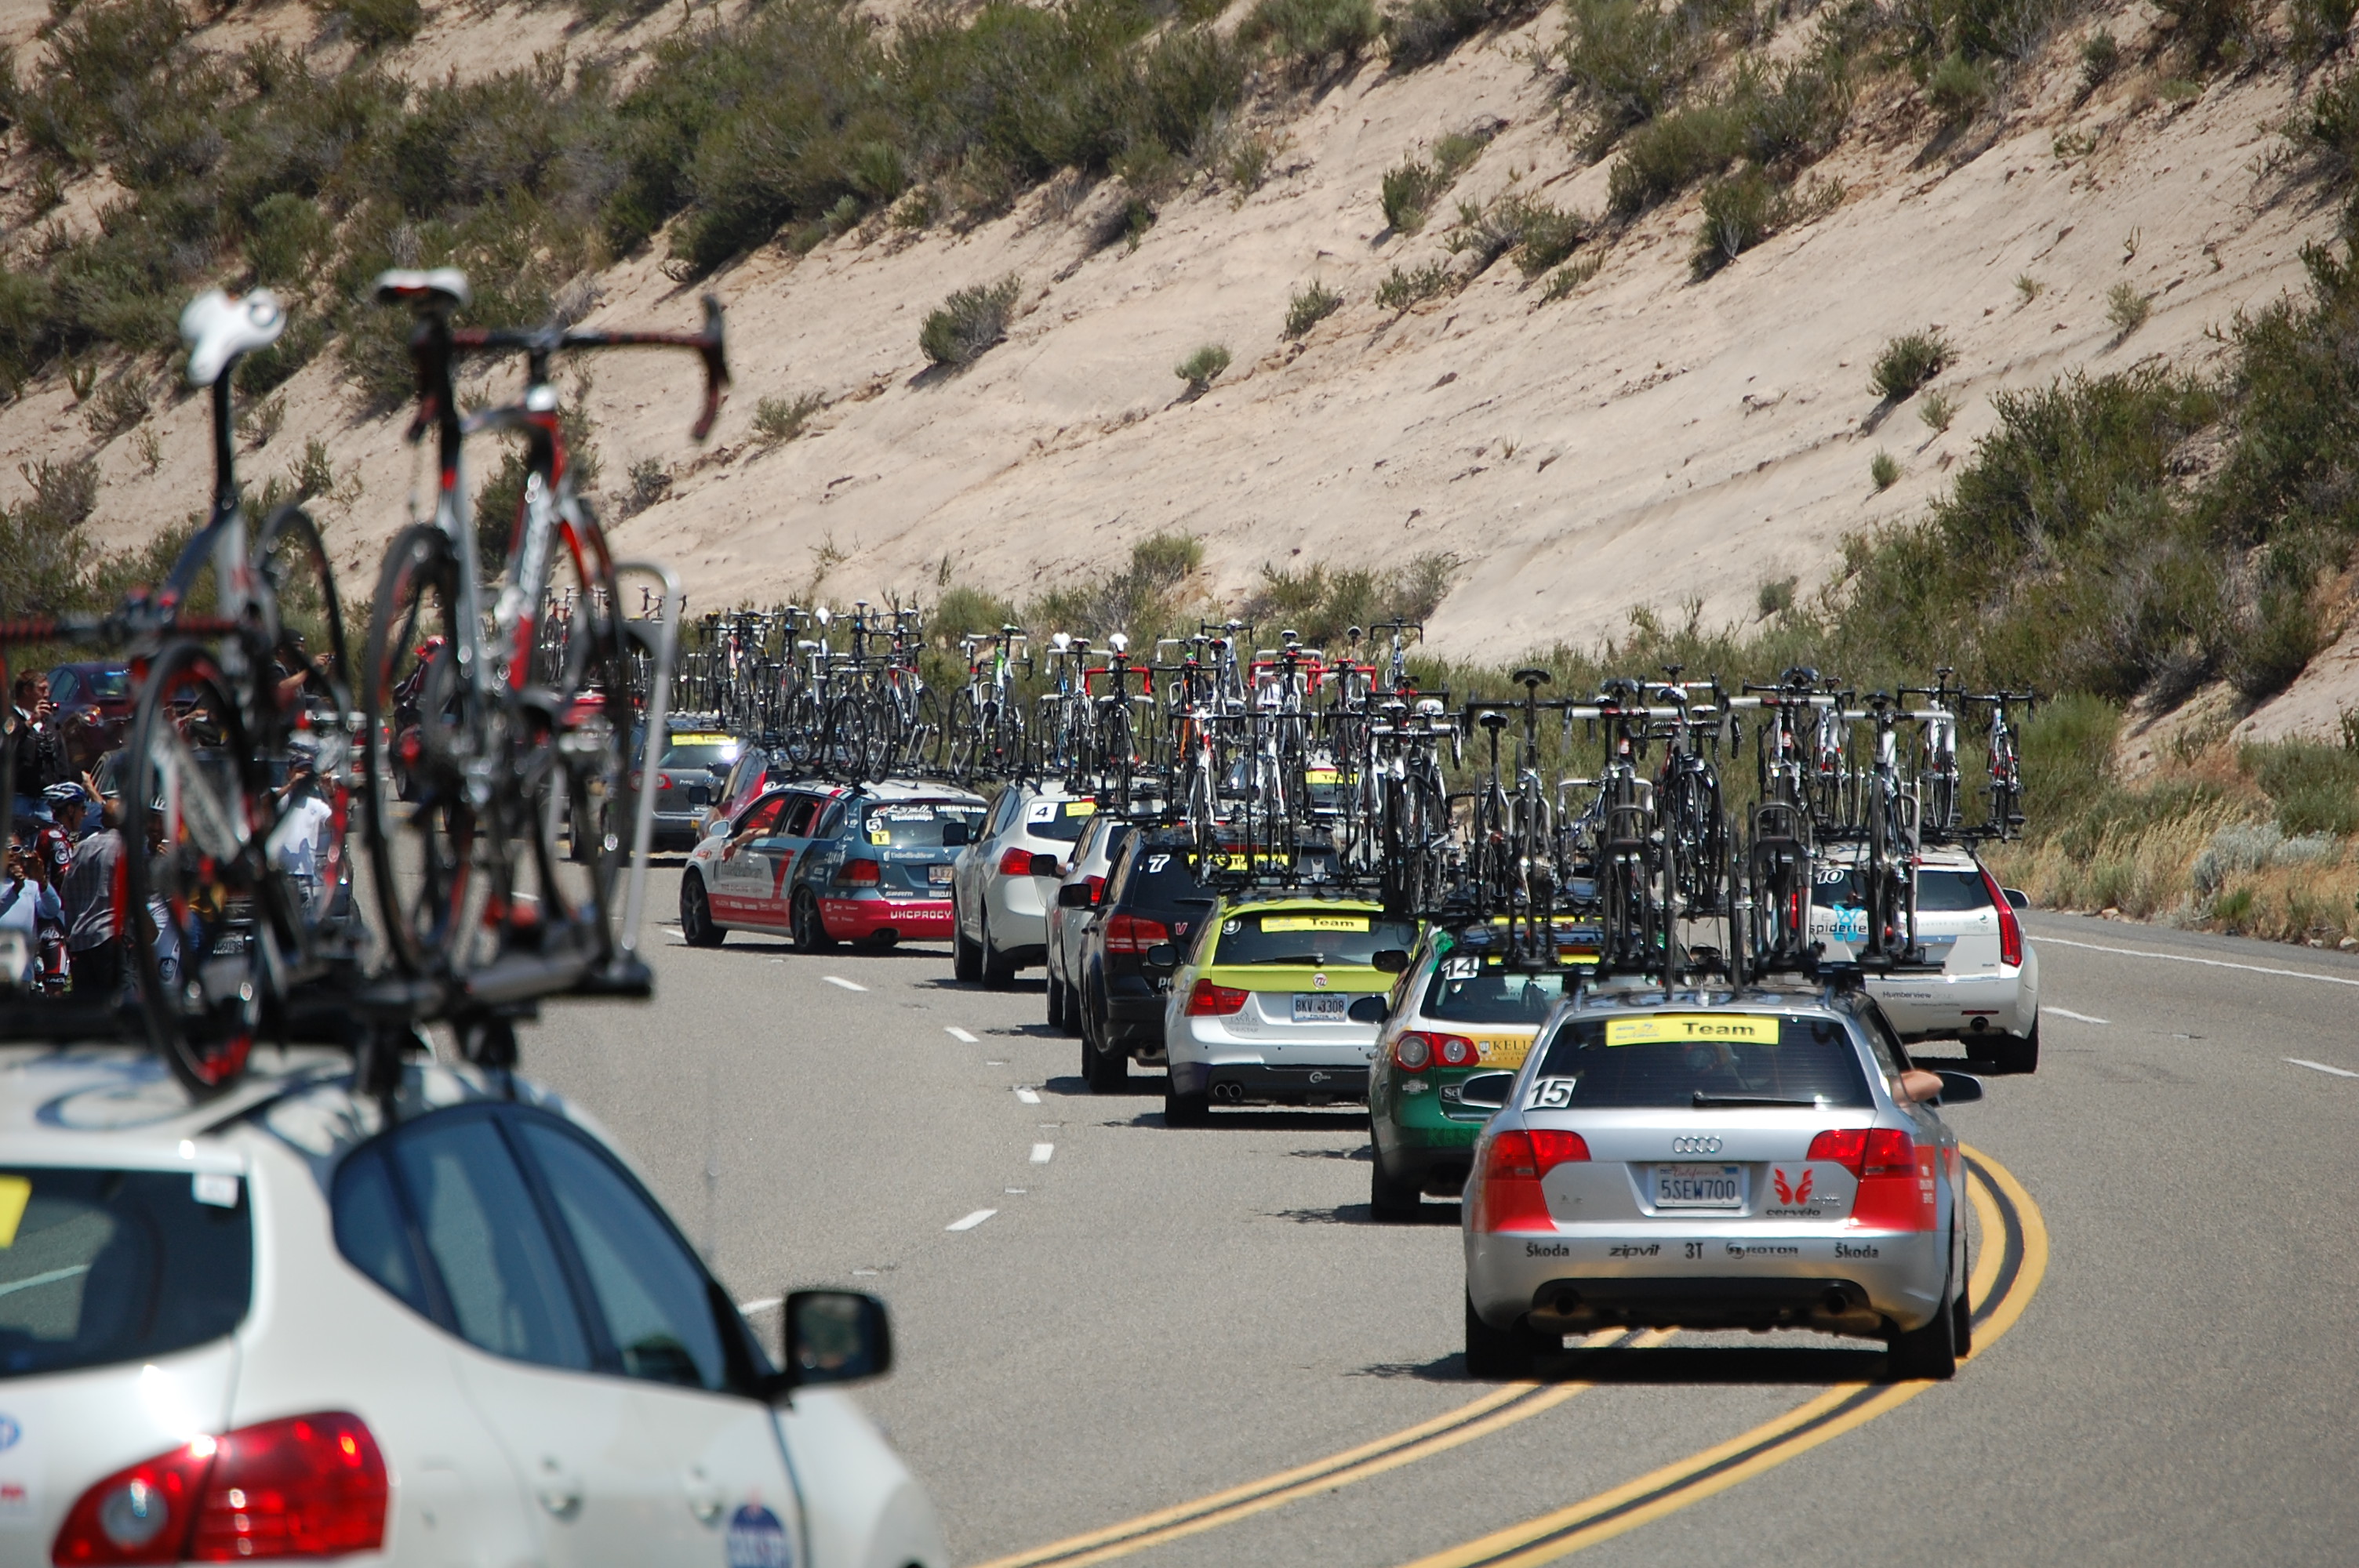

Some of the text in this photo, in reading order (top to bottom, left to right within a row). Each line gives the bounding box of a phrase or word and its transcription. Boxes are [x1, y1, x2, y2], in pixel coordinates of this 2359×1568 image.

[1035, 806, 1048, 818] 4
[867, 818, 881, 831] 5
[875, 833, 885, 842] T
[1149, 855, 1170, 873] 7
[1817, 869, 1845, 884] 10
[1175, 923, 1188, 935] V
[1222, 920, 1241, 935] 9
[1309, 917, 1354, 927] Team
[1441, 958, 1479, 978] 14
[1296, 1000, 1313, 1012] BKV
[1682, 1022, 1755, 1036] Team
[1532, 1080, 1575, 1106] 15
[1661, 1179, 1736, 1200] 5SEW700
[1525, 1243, 1571, 1258] Škoda
[1608, 1244, 1662, 1259] zipvit
[1685, 1243, 1703, 1260] 3T
[1834, 1243, 1879, 1259] Škoda
